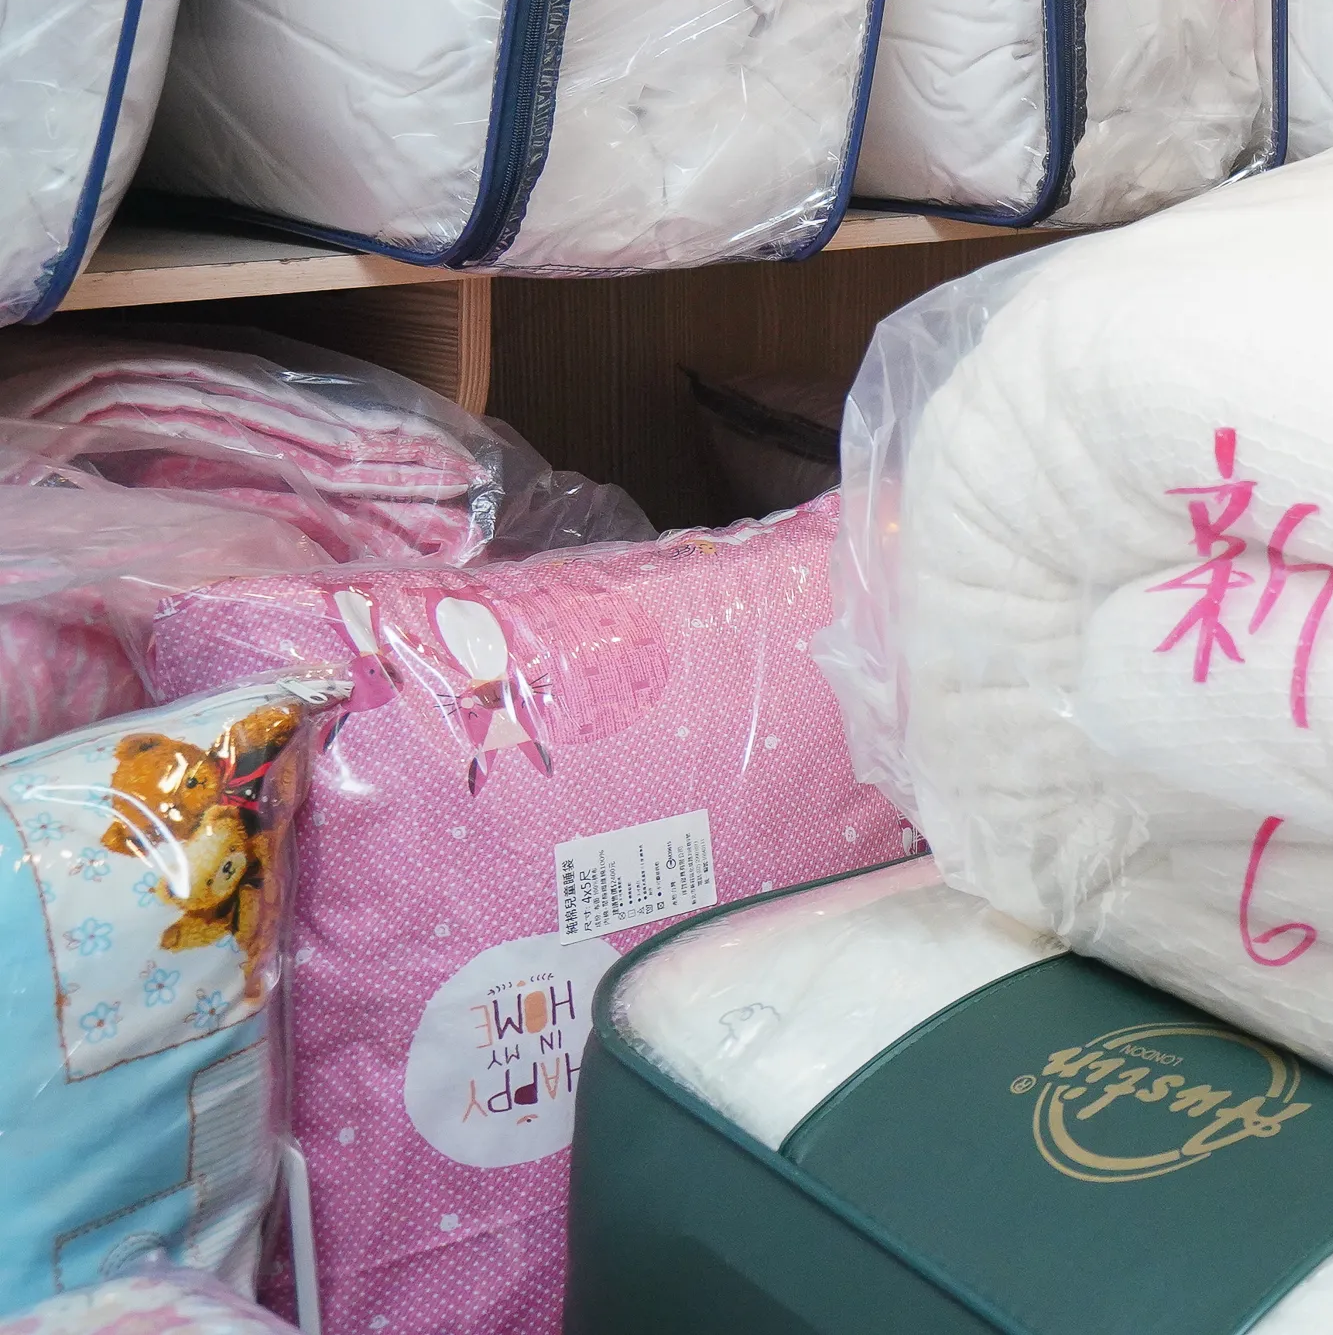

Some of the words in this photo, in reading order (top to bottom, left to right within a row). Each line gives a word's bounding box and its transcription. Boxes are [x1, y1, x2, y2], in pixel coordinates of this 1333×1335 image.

[562, 858, 579, 935] 純棉兒童睡袋
[470, 980, 576, 1049] HOME
[487, 1043, 521, 1070] MY
[540, 1029, 563, 1054] IN
[1118, 1043, 1184, 1067] LONDON
[1041, 1047, 1312, 1156] Austin
